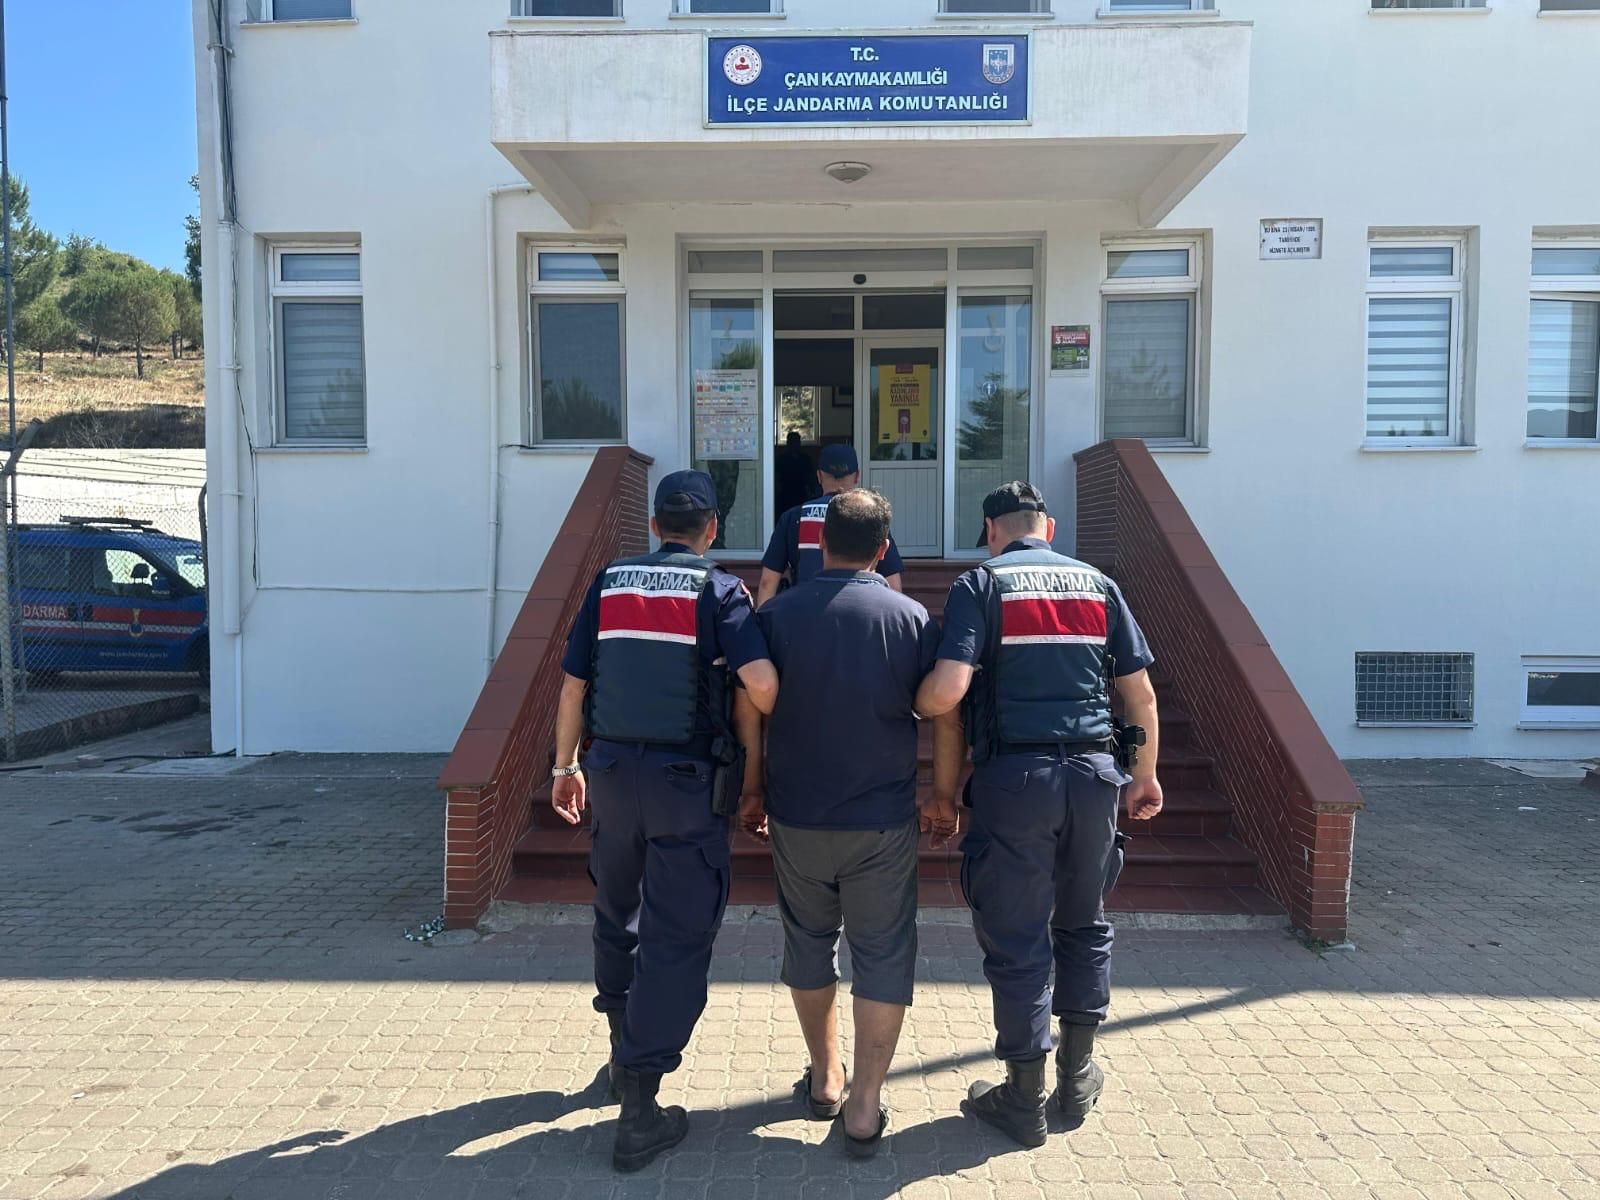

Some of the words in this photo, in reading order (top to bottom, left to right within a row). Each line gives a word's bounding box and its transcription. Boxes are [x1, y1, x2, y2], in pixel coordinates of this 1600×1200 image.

[850, 47, 880, 61] T.C.
[784, 71, 819, 90] ÇAN
[821, 67, 949, 86] KAYMAKAMLIĞI
[727, 94, 768, 115] İLÇE
[773, 95, 874, 112] JANDARMA
[879, 92, 1009, 111] KOMUTANLIĞI
[610, 571, 692, 591] JANDARMA
[1010, 572, 1097, 592] JANDARMA
